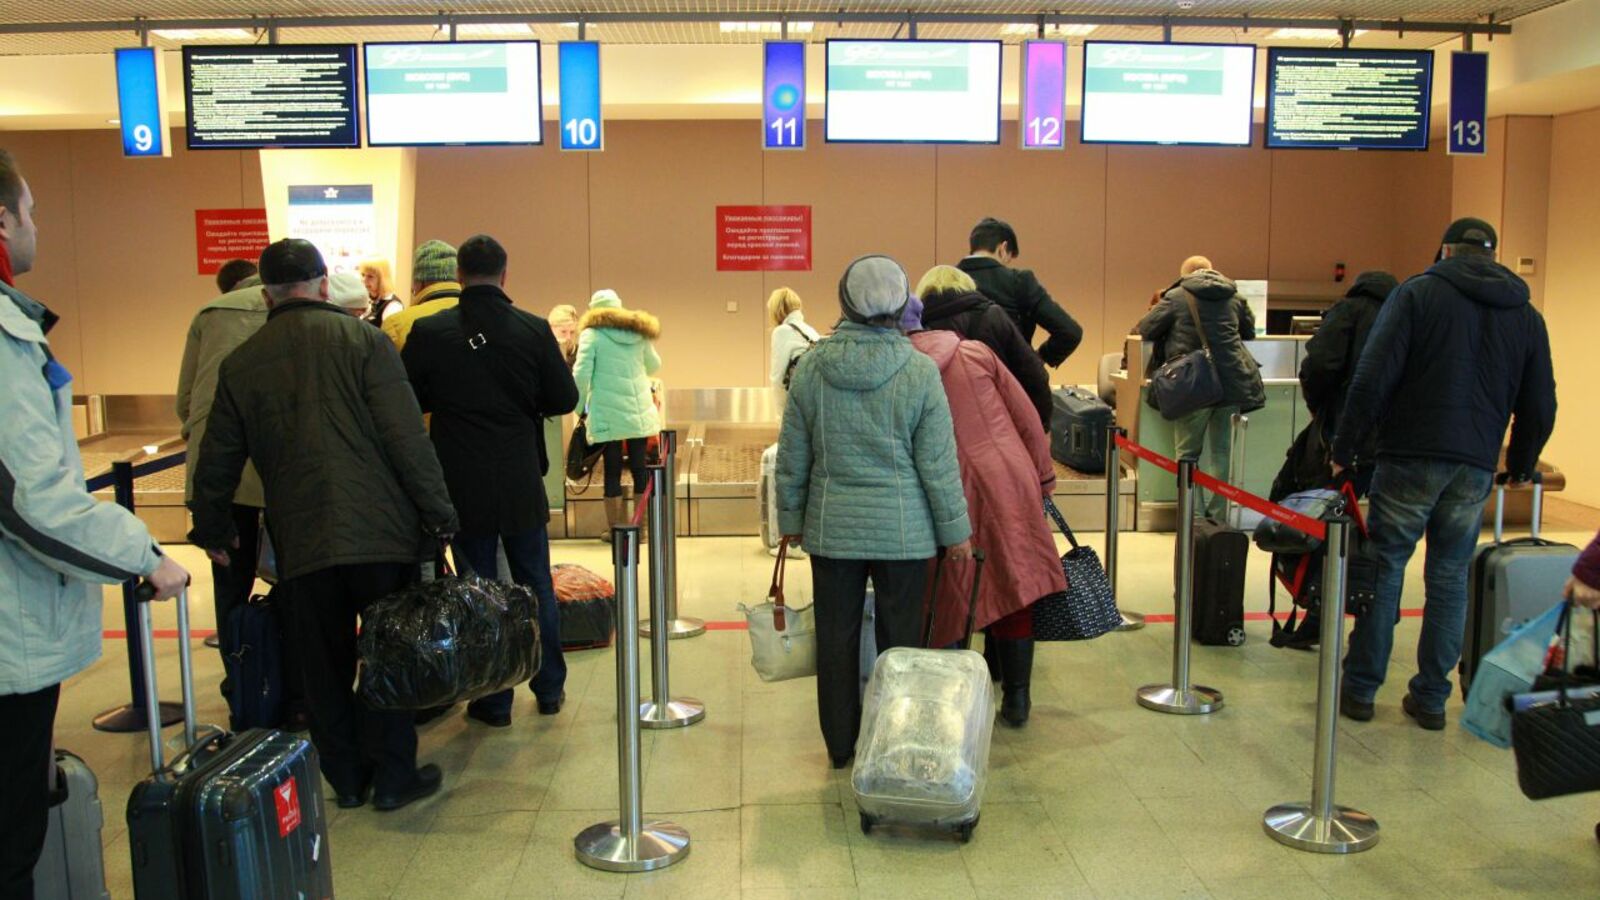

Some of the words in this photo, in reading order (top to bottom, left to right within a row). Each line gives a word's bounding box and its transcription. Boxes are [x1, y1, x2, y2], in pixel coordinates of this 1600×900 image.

[133, 124, 152, 151] 9
[565, 118, 597, 145] 10
[771, 117, 796, 145] 11
[1029, 116, 1059, 145] 12
[1453, 119, 1481, 146] 13
